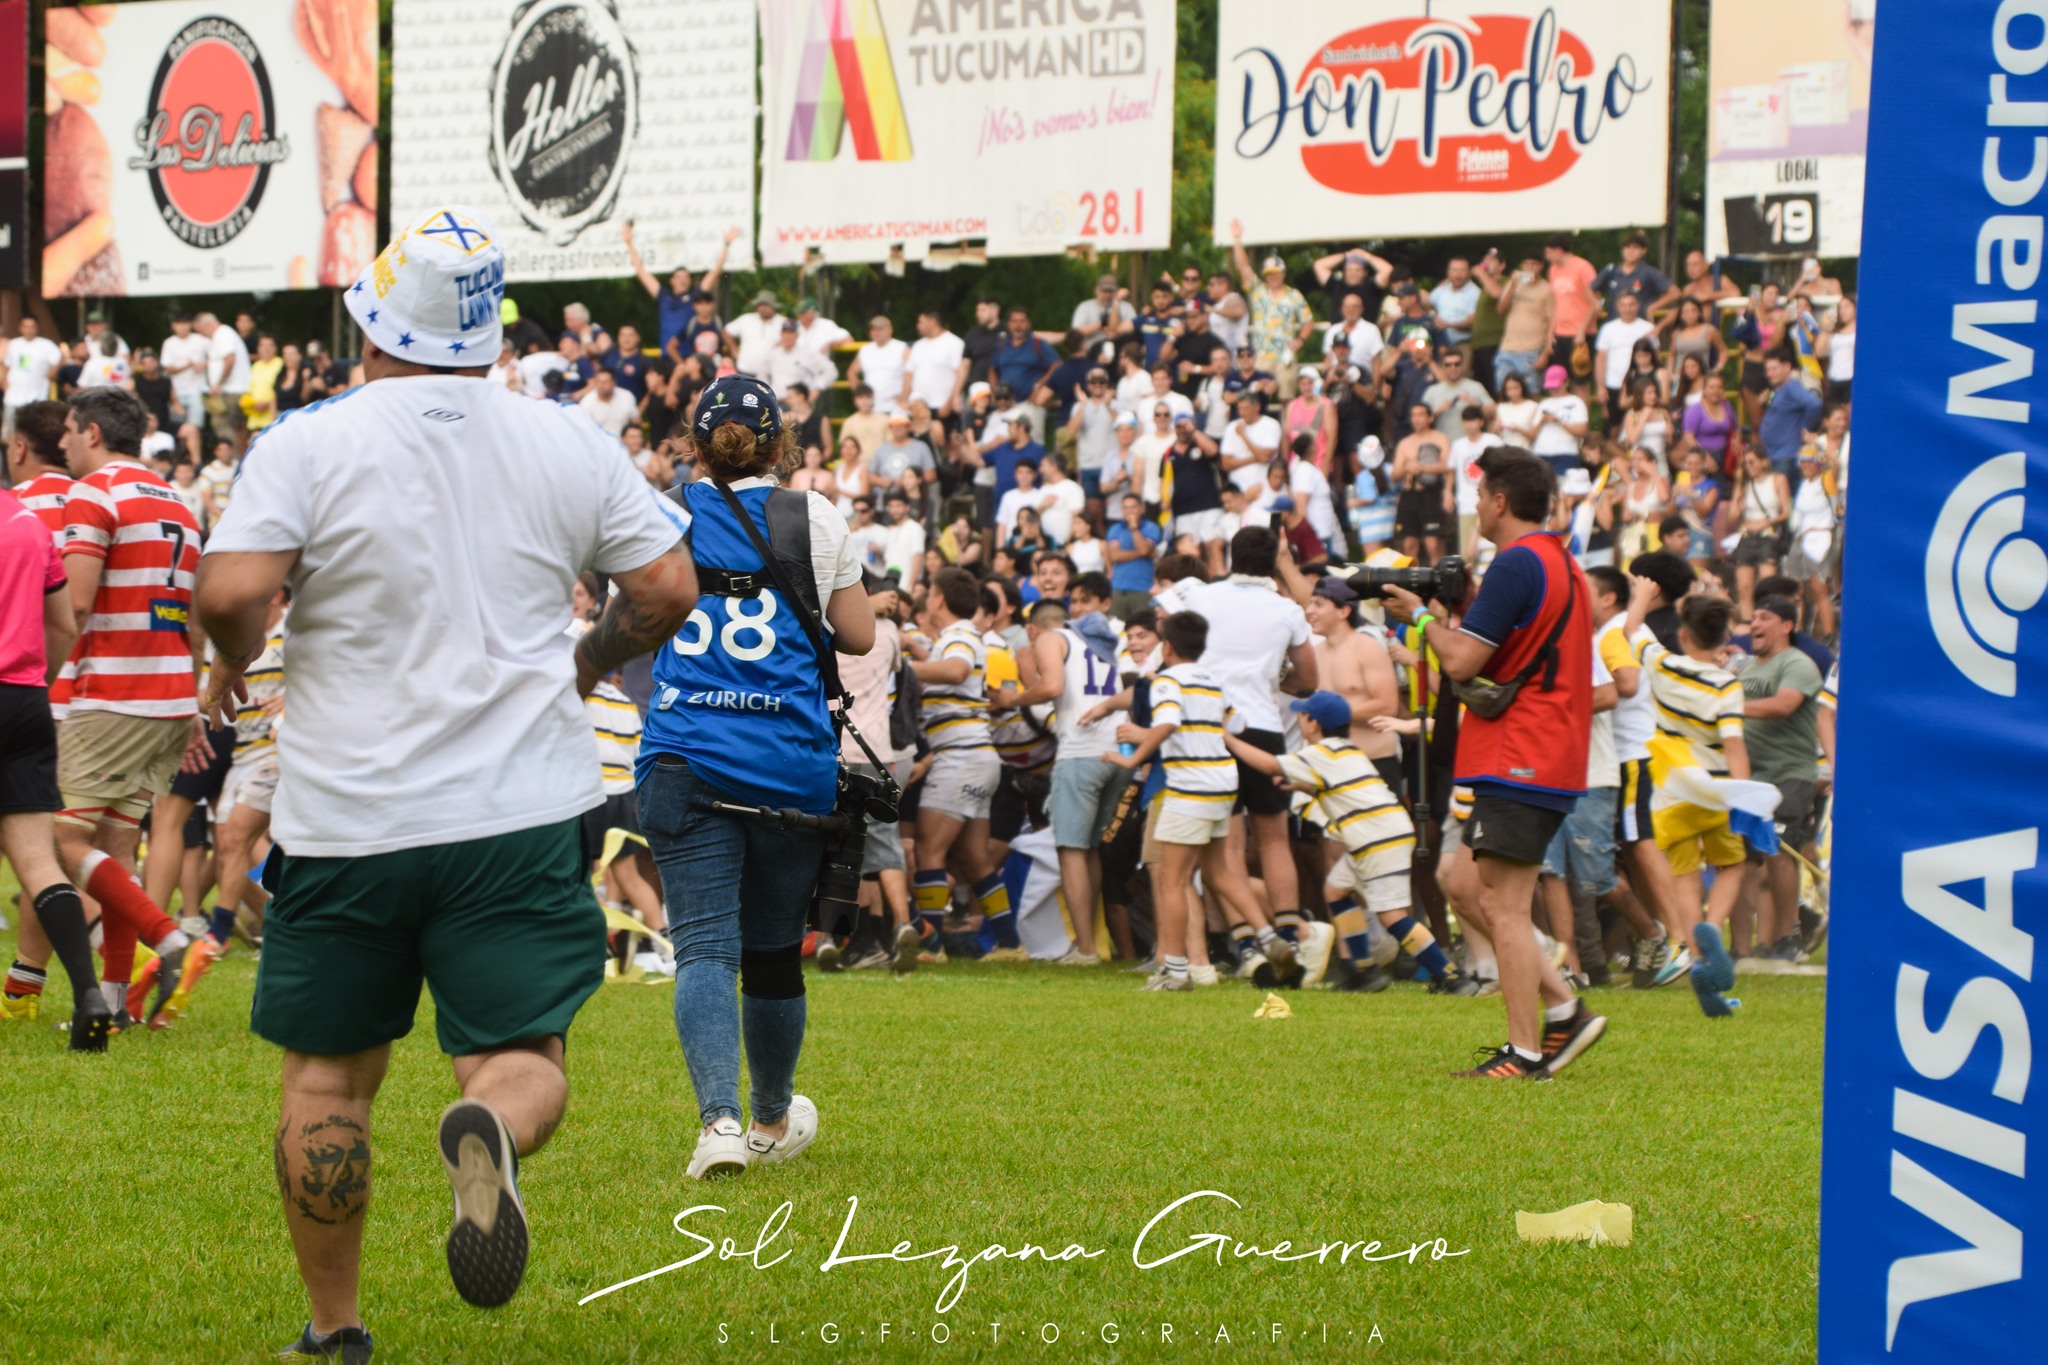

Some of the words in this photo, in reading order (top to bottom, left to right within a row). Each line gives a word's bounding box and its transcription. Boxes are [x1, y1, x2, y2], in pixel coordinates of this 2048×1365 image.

[908, 33, 1083, 87] TUCUMAN
[1089, 27, 1146, 77] HD
[1231, 47, 1401, 159] Don
[1408, 7, 1654, 158] Pedro
[507, 54, 623, 172] Heller
[1033, 103, 1099, 138] vemos
[1105, 66, 1163, 126] bien!
[128, 109, 182, 170] Las
[179, 104, 290, 172] Delicias
[1776, 158, 1819, 183] LOCAL
[776, 217, 988, 243] WWW.AMERICATUCUMAN.COM
[1077, 188, 1144, 237] 28.1
[1764, 199, 1814, 245] 19
[1946, 0, 2048, 423] Macro
[157, 518, 185, 590] 7
[687, 690, 782, 713] ZURICH
[1083, 648, 1118, 697] 17
[1886, 826, 2039, 1353] VISA
